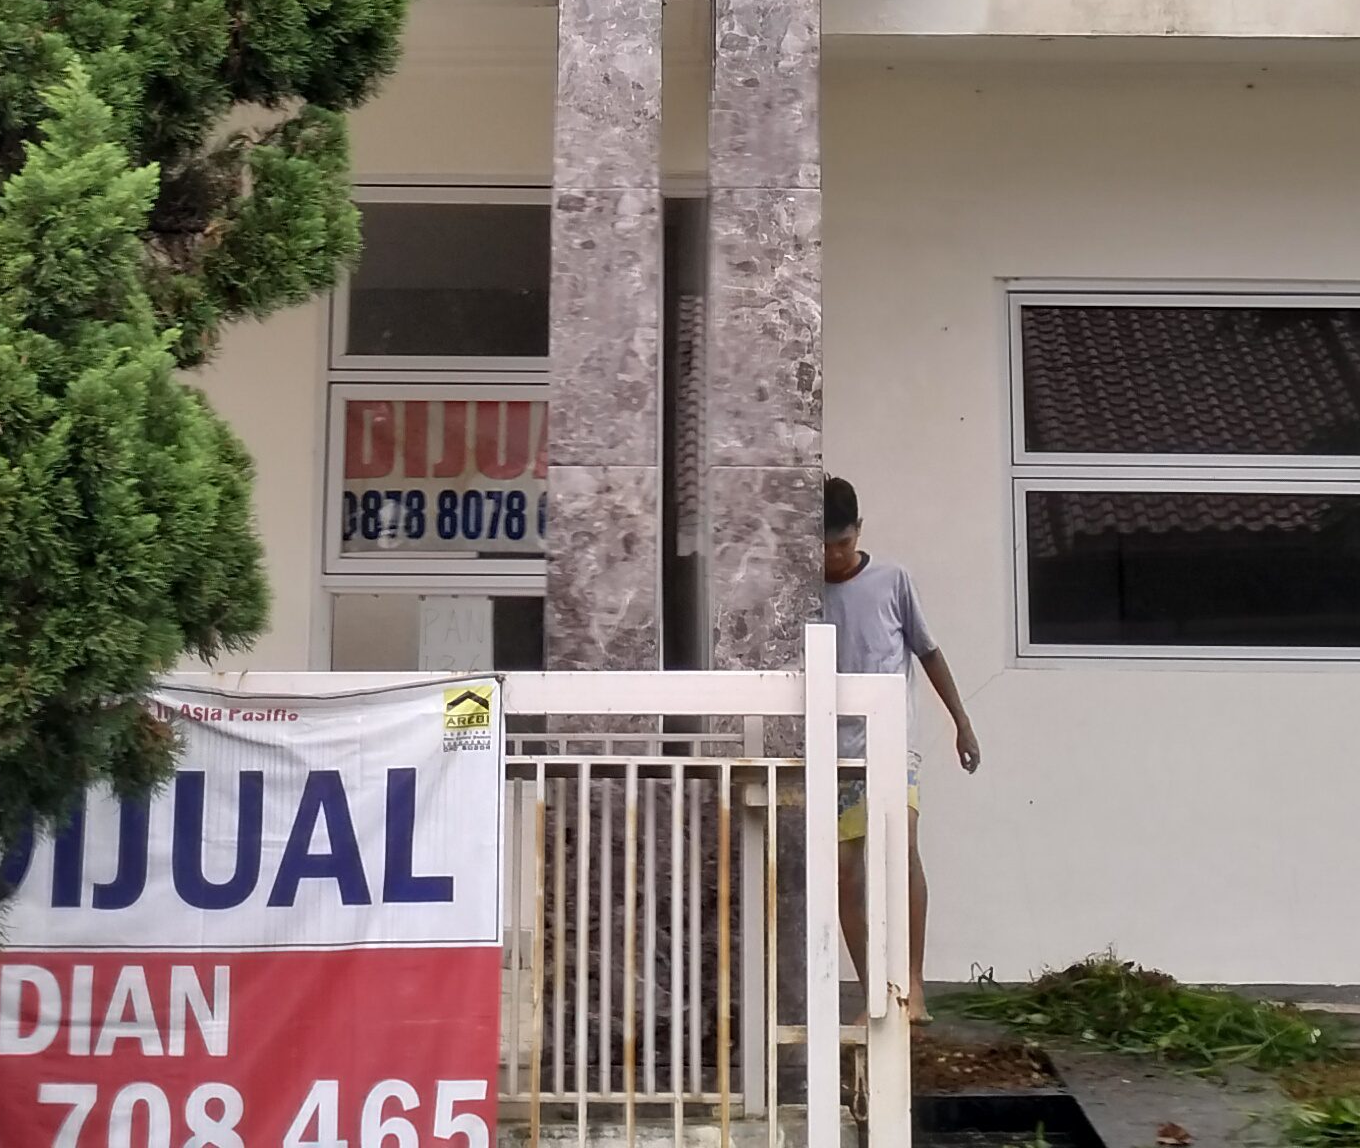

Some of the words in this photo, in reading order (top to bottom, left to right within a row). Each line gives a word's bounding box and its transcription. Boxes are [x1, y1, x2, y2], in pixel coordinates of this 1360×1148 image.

[437, 490, 526, 539] 8078
[37, 1083, 245, 1148] 708
[283, 1079, 490, 1148] 465
